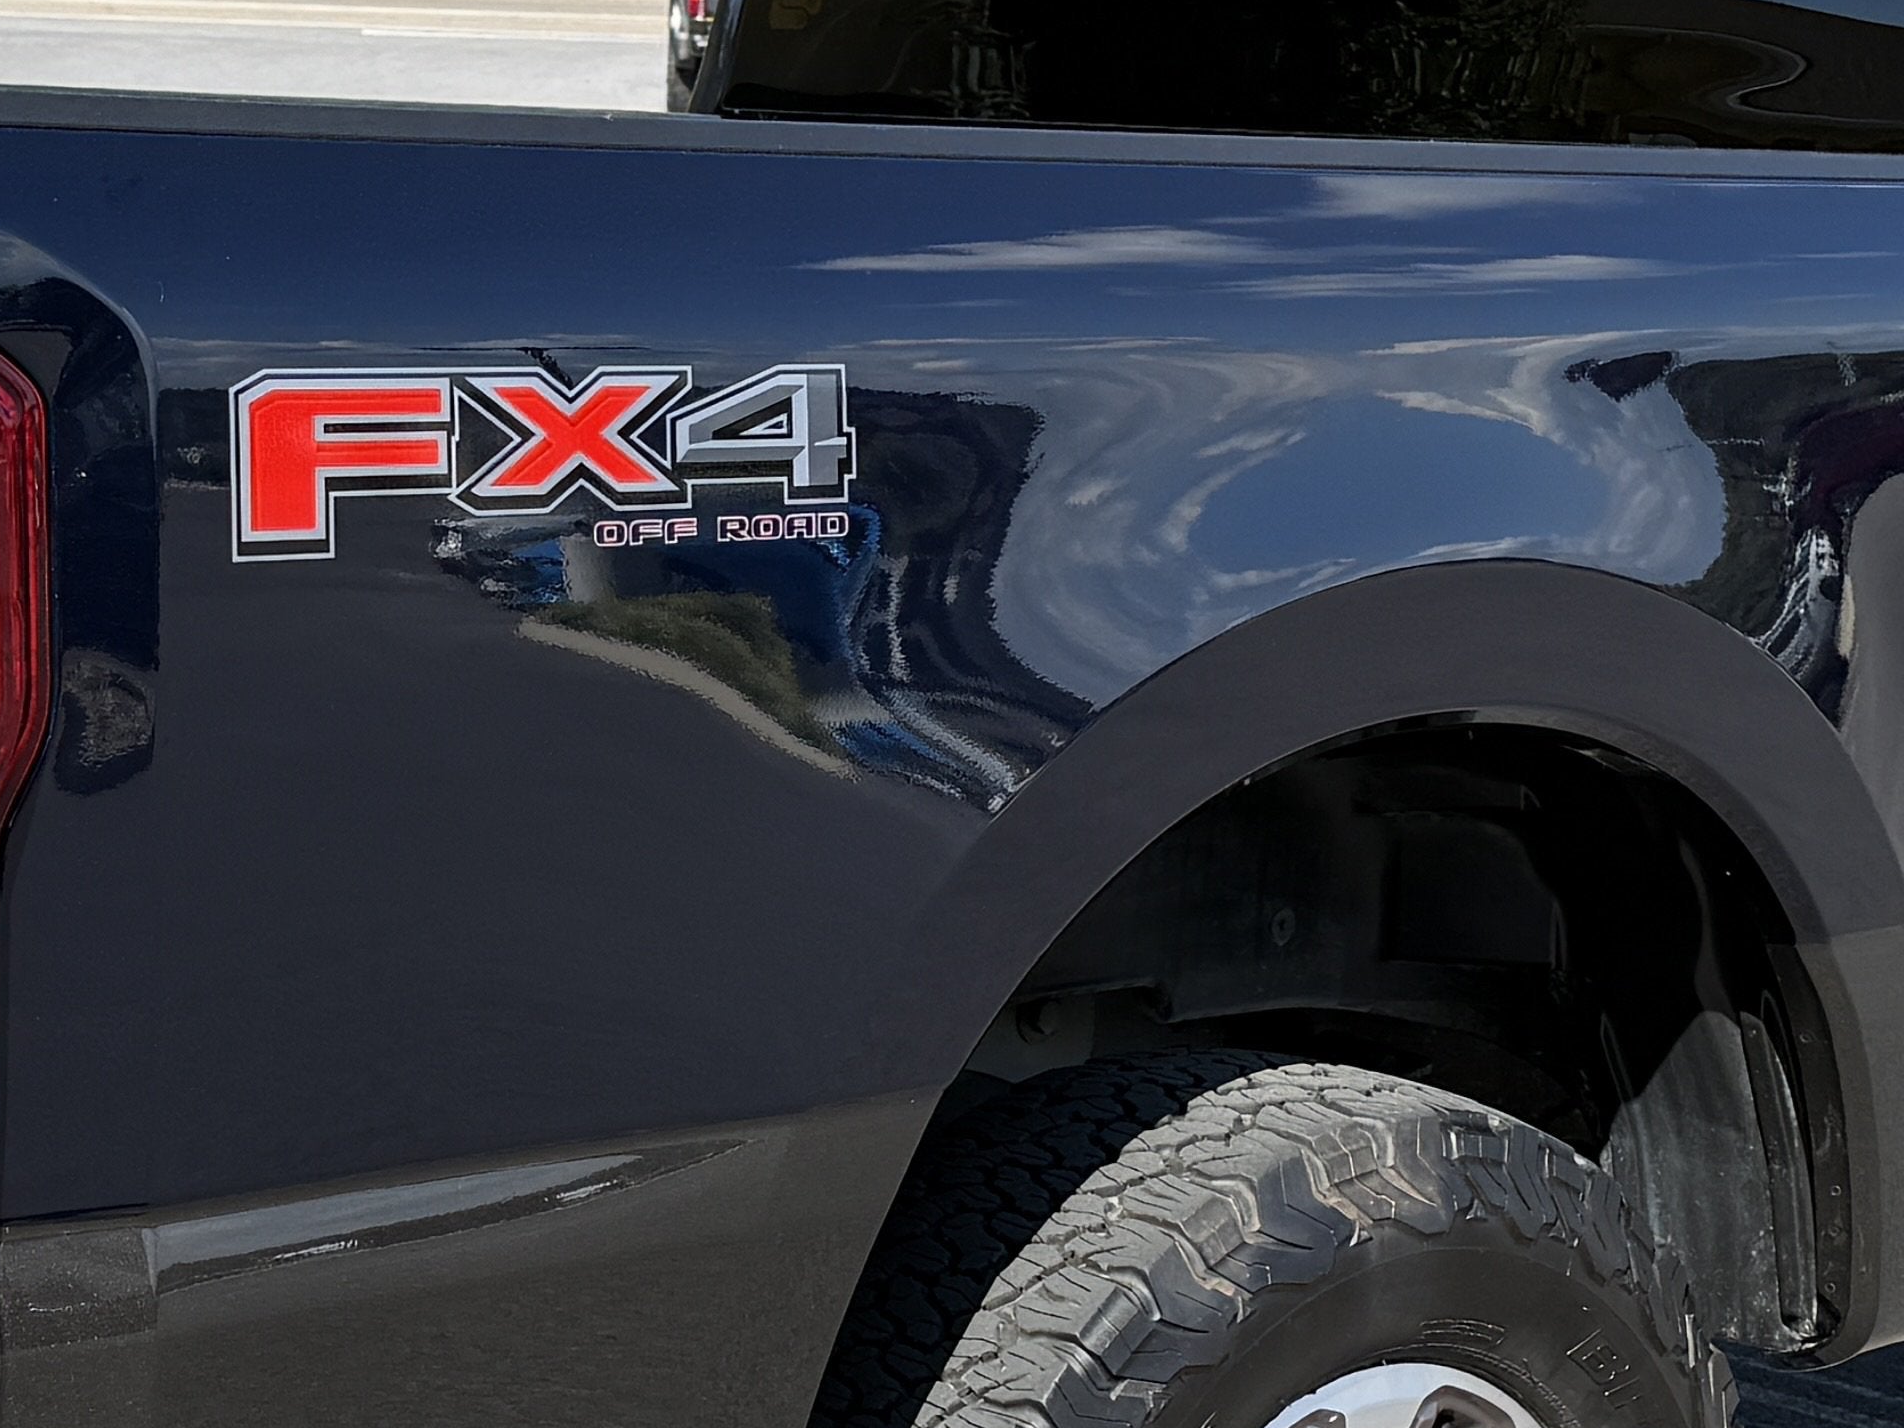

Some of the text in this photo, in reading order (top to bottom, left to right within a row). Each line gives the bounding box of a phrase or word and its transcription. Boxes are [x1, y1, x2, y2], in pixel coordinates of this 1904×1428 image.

[228, 363, 857, 563] FX4
[593, 511, 850, 548] OFF ROAD
